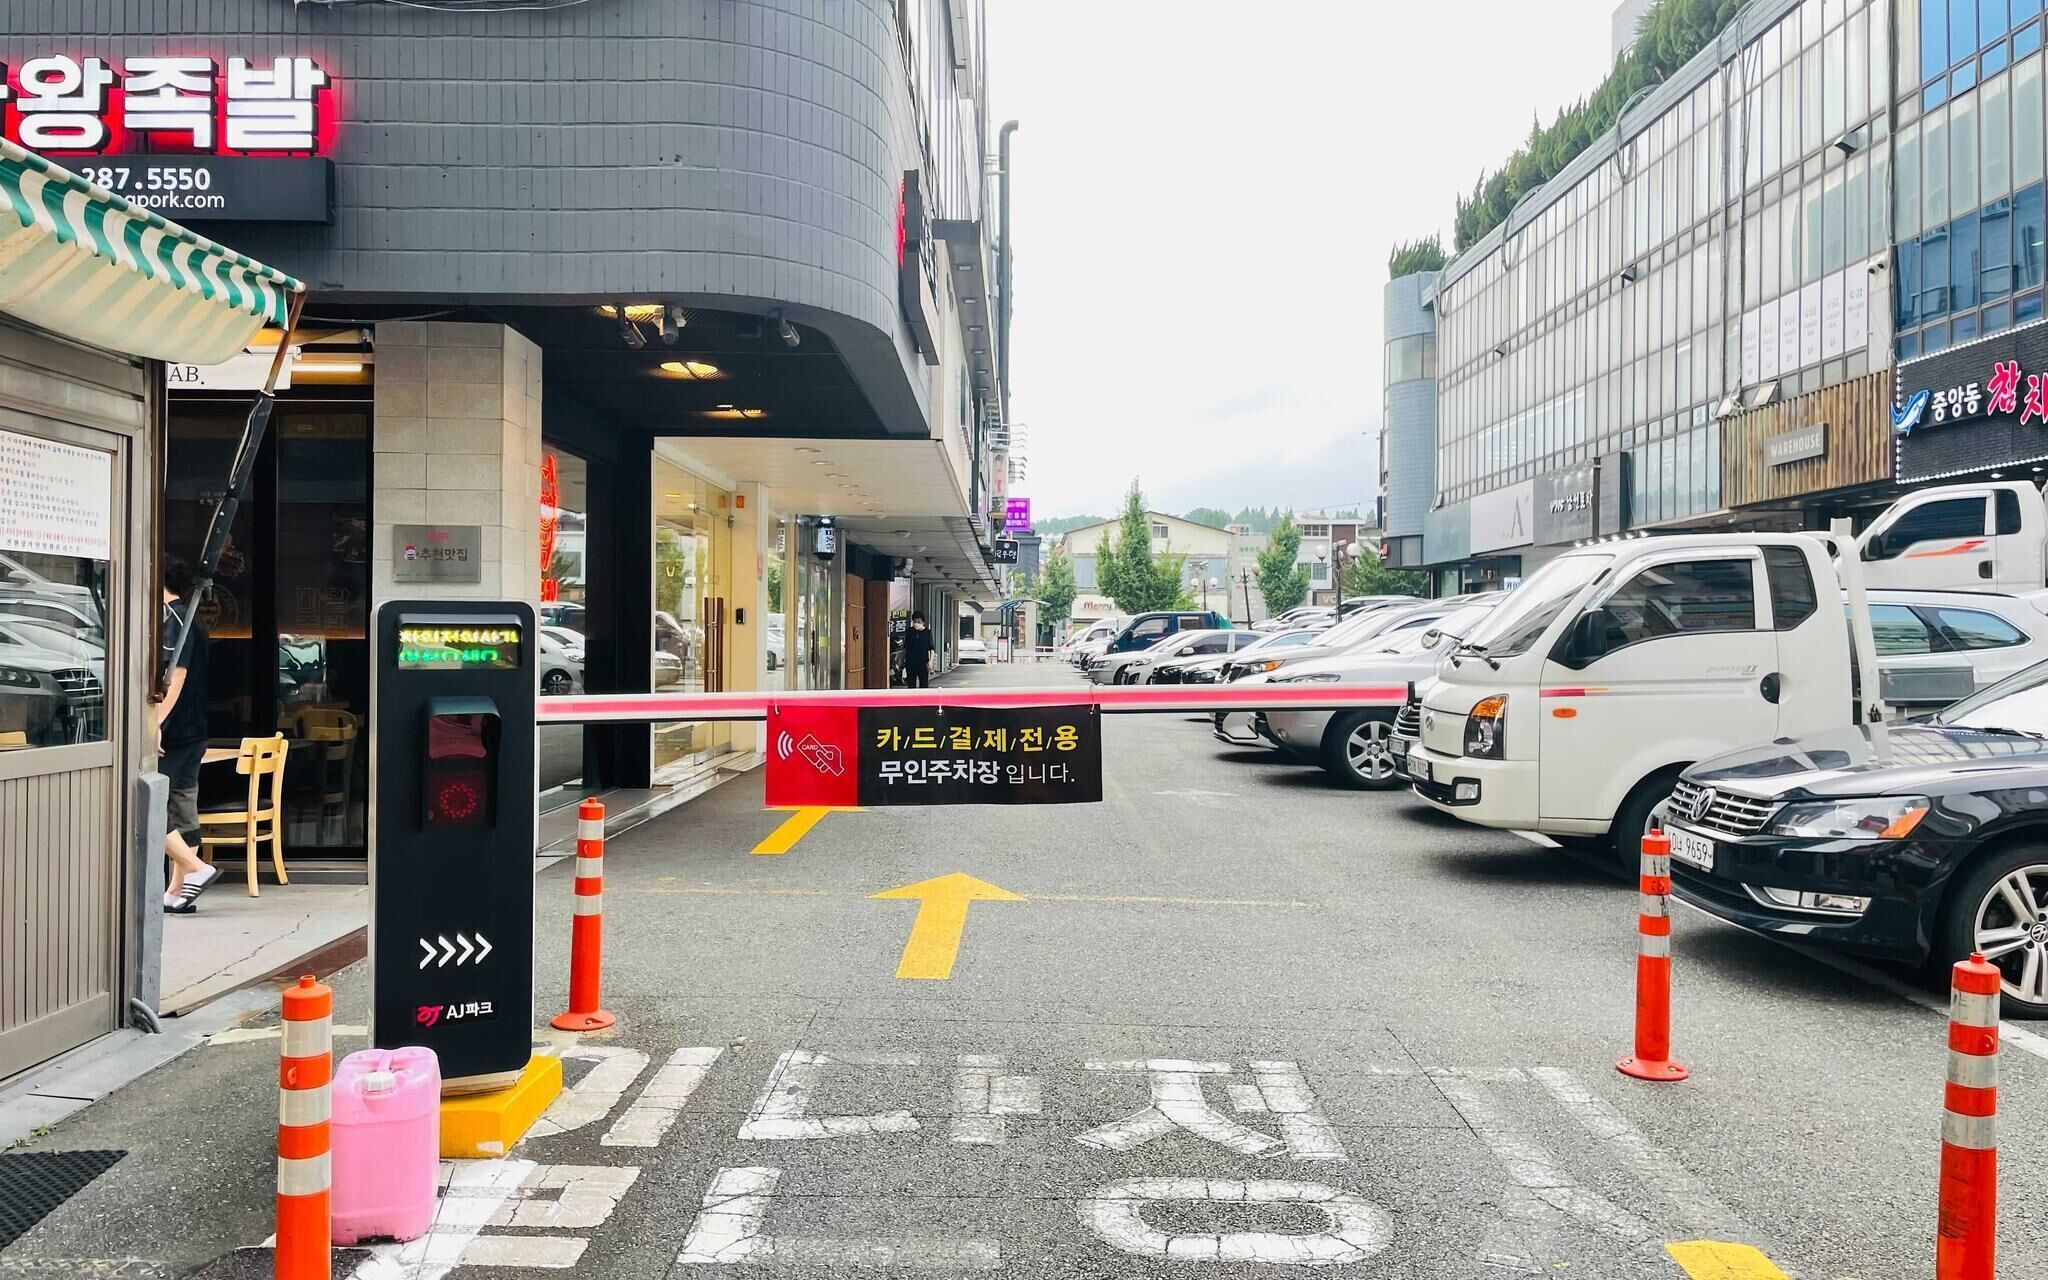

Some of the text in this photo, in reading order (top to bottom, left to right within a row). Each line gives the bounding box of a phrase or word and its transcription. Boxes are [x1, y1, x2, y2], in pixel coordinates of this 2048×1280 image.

[0, 55, 326, 149] 왕족발
[1931, 382, 1982, 422] 중앙동
[1770, 434, 1821, 458] WAREHOUSE
[419, 547, 468, 562] 추천맛집
[801, 743, 819, 751] CARD
[876, 724, 1079, 752] 카/드/결/제/전/용
[878, 758, 1077, 785] 무인주차장 입니다.
[1686, 837, 1708, 863] 9659
[446, 1001, 494, 1020] AJ파크
